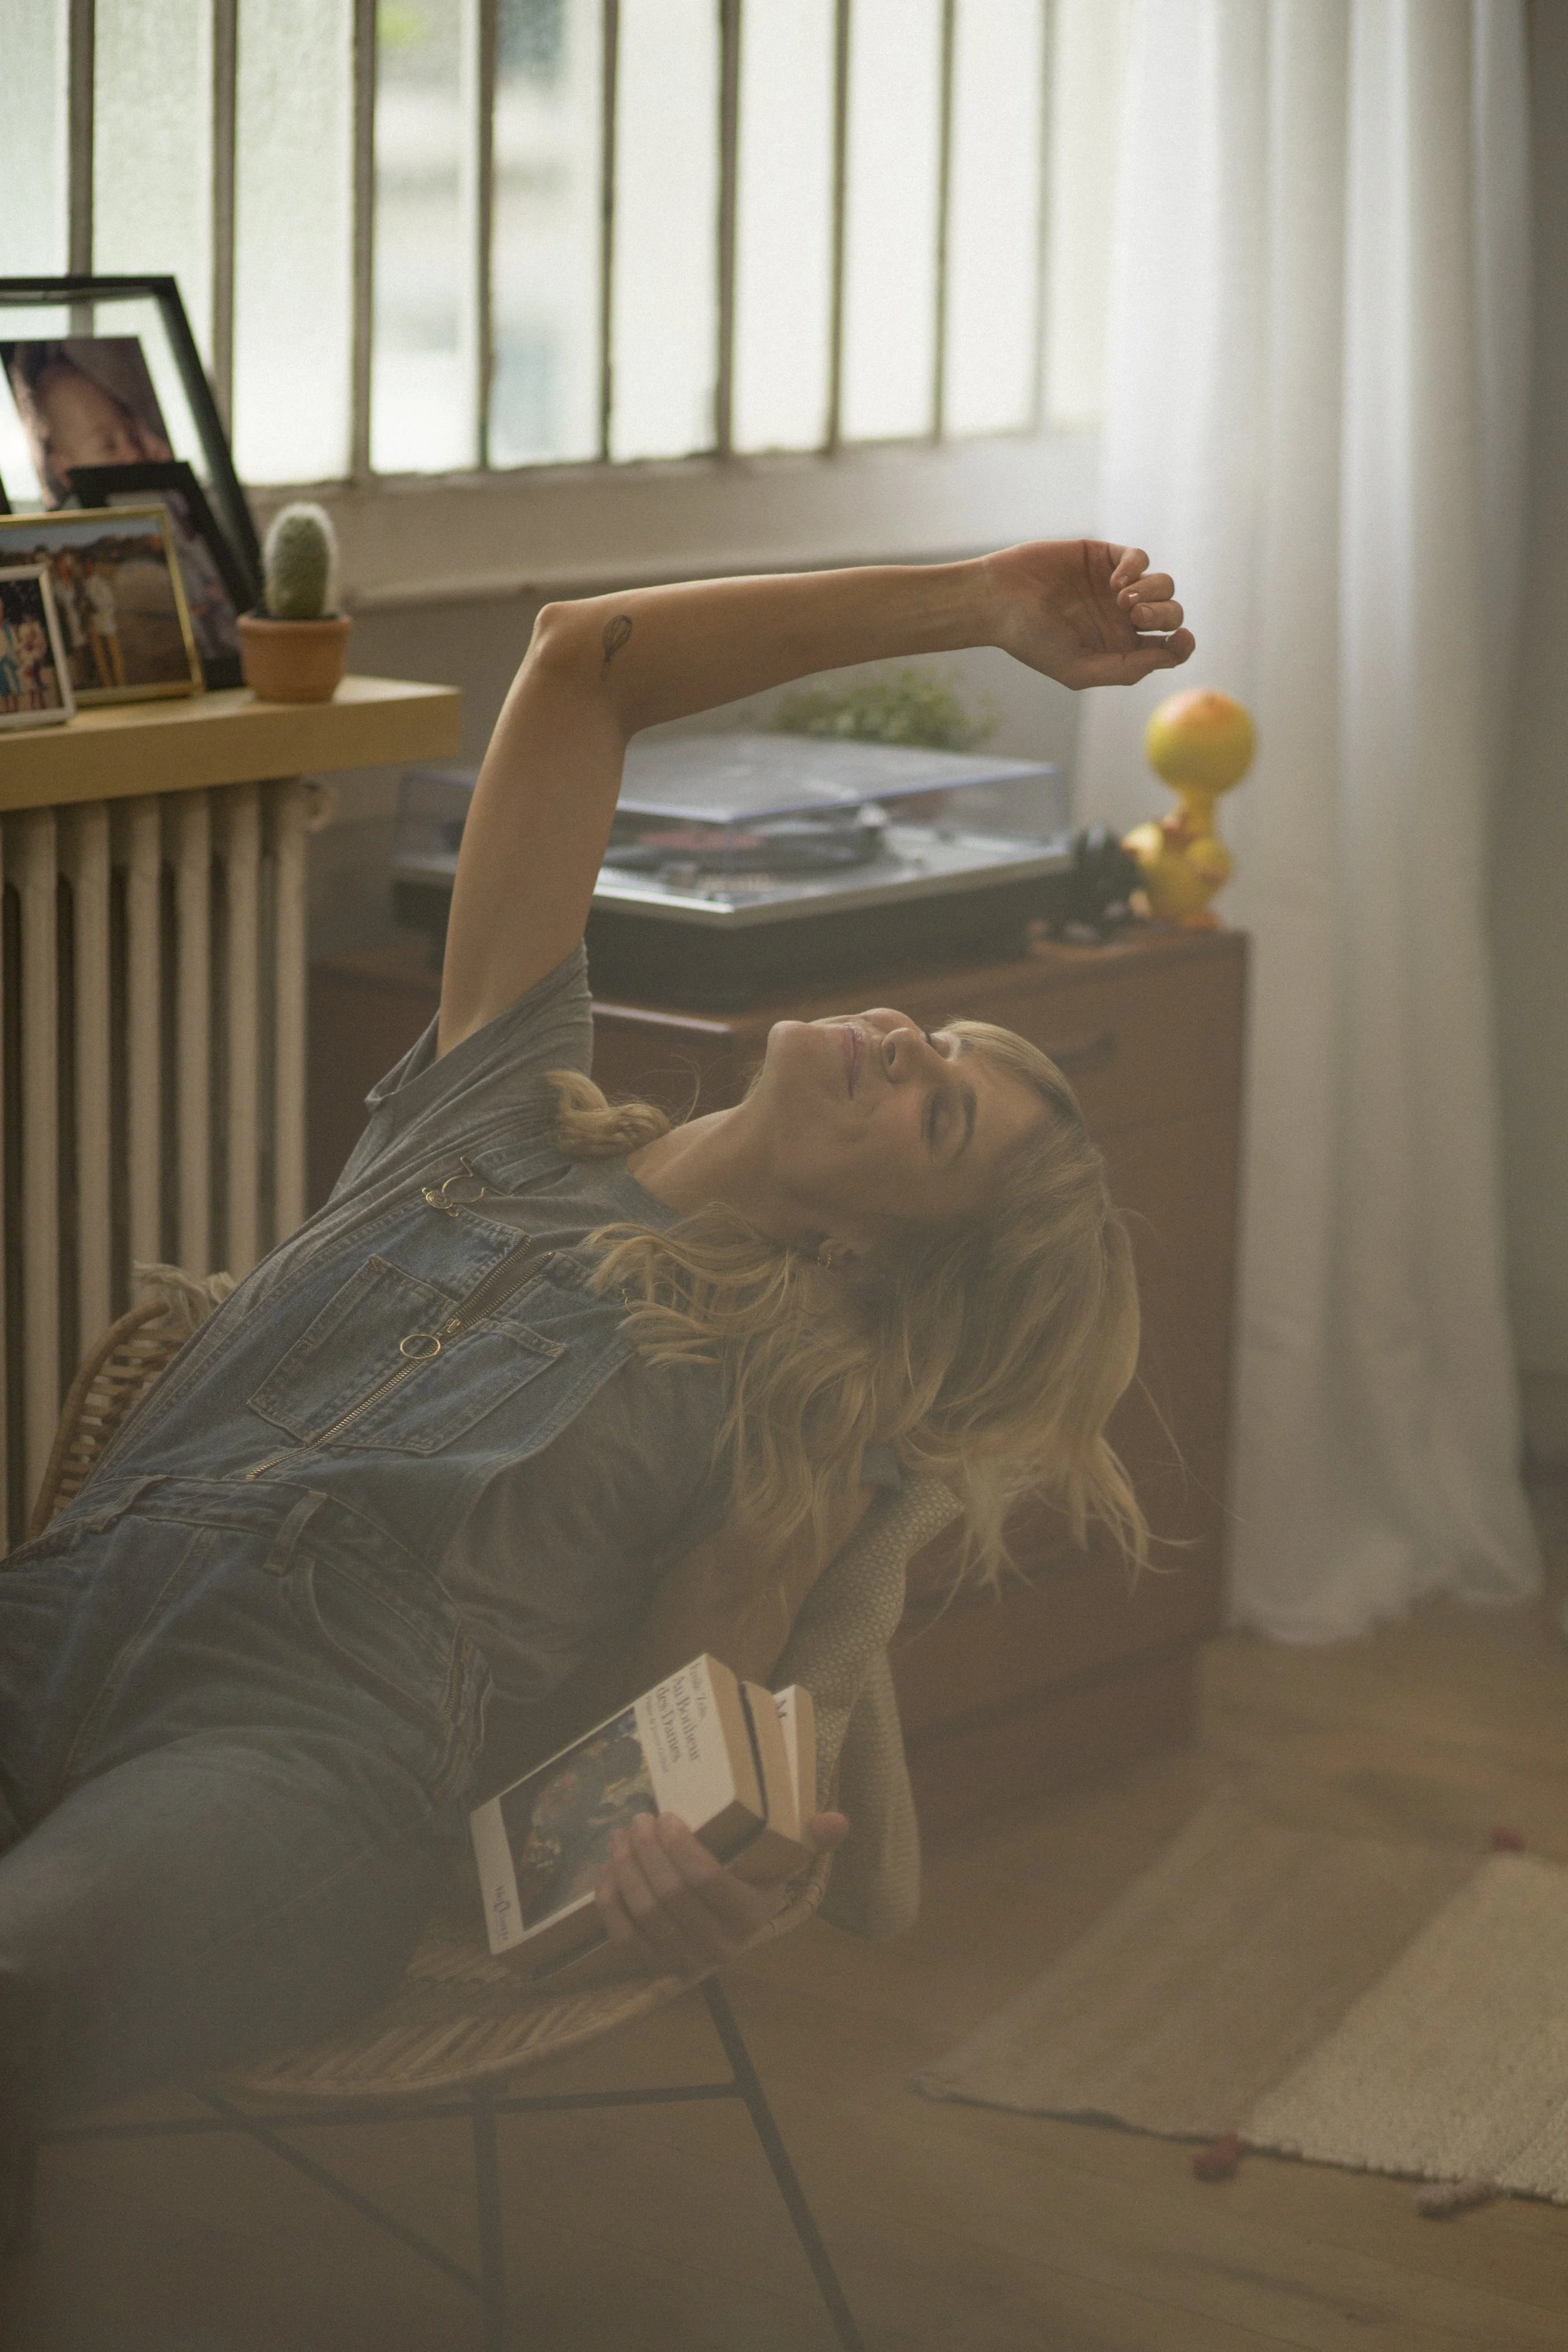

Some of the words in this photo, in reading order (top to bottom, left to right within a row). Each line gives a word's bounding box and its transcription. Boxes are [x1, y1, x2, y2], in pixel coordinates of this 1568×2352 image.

[657, 1687, 670, 1712] des
[671, 1675, 686, 1699] Au
[662, 1710, 681, 1764] Dames
[677, 1696, 700, 1762] Bonheur
